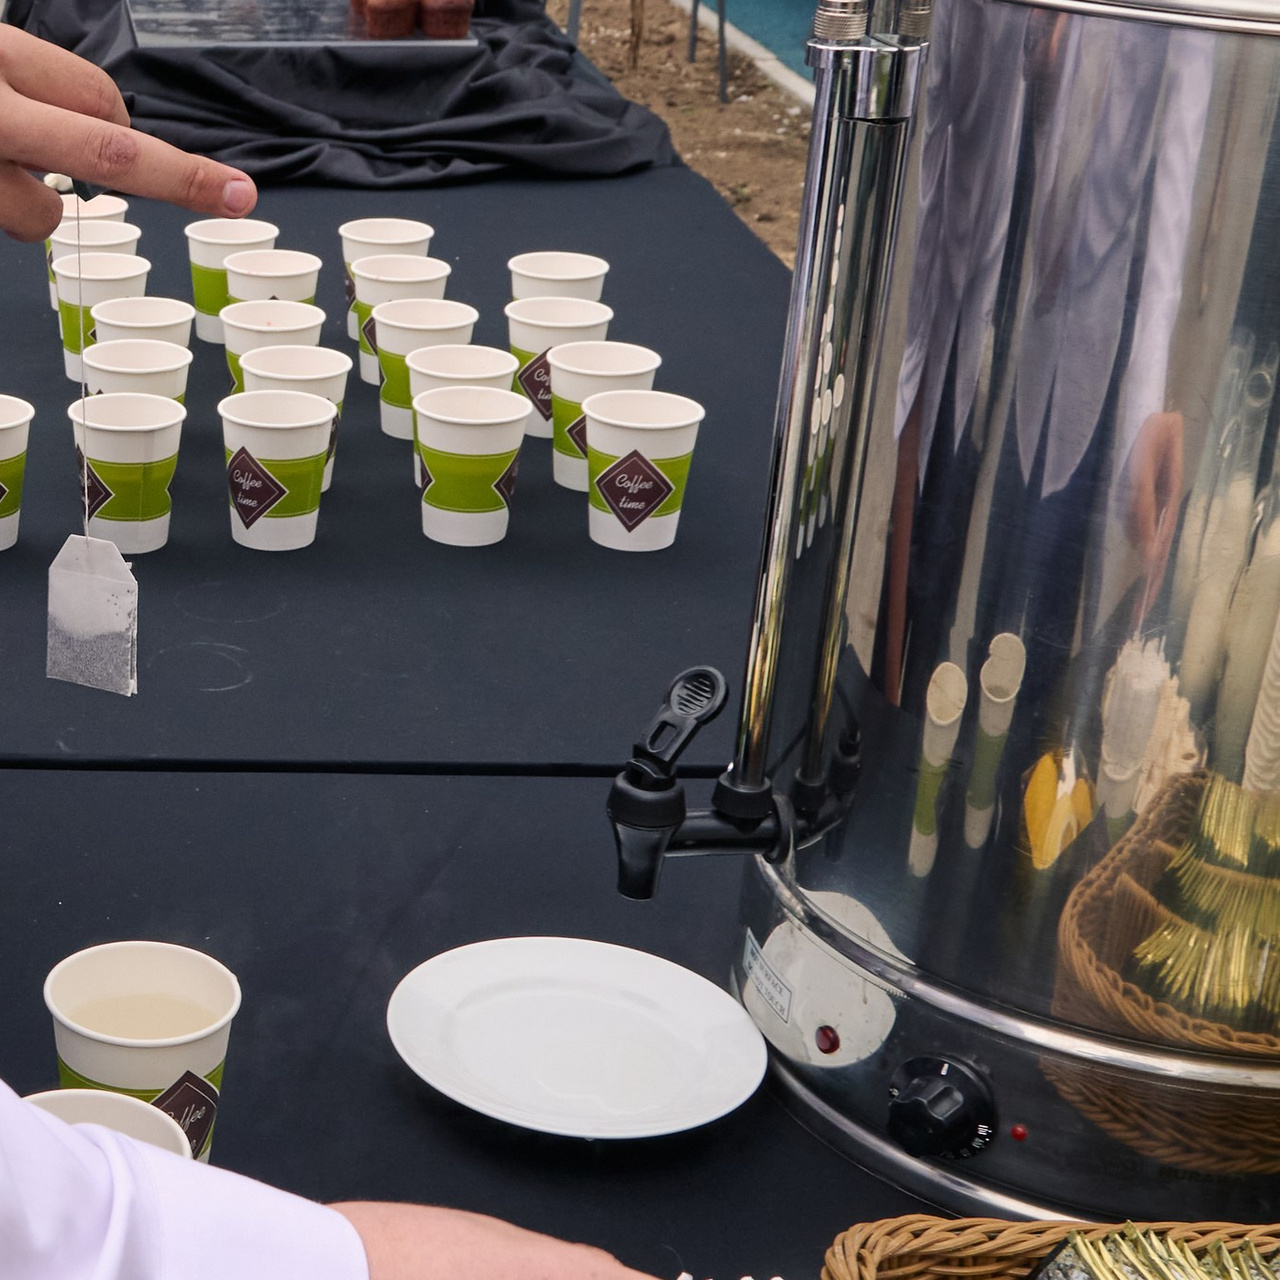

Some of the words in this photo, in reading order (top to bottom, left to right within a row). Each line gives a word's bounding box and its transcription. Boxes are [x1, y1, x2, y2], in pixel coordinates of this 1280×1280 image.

[232, 469, 263, 491] Coffee
[614, 473, 654, 494] Coffee
[236, 491, 259, 508] time
[618, 495, 646, 510] time
